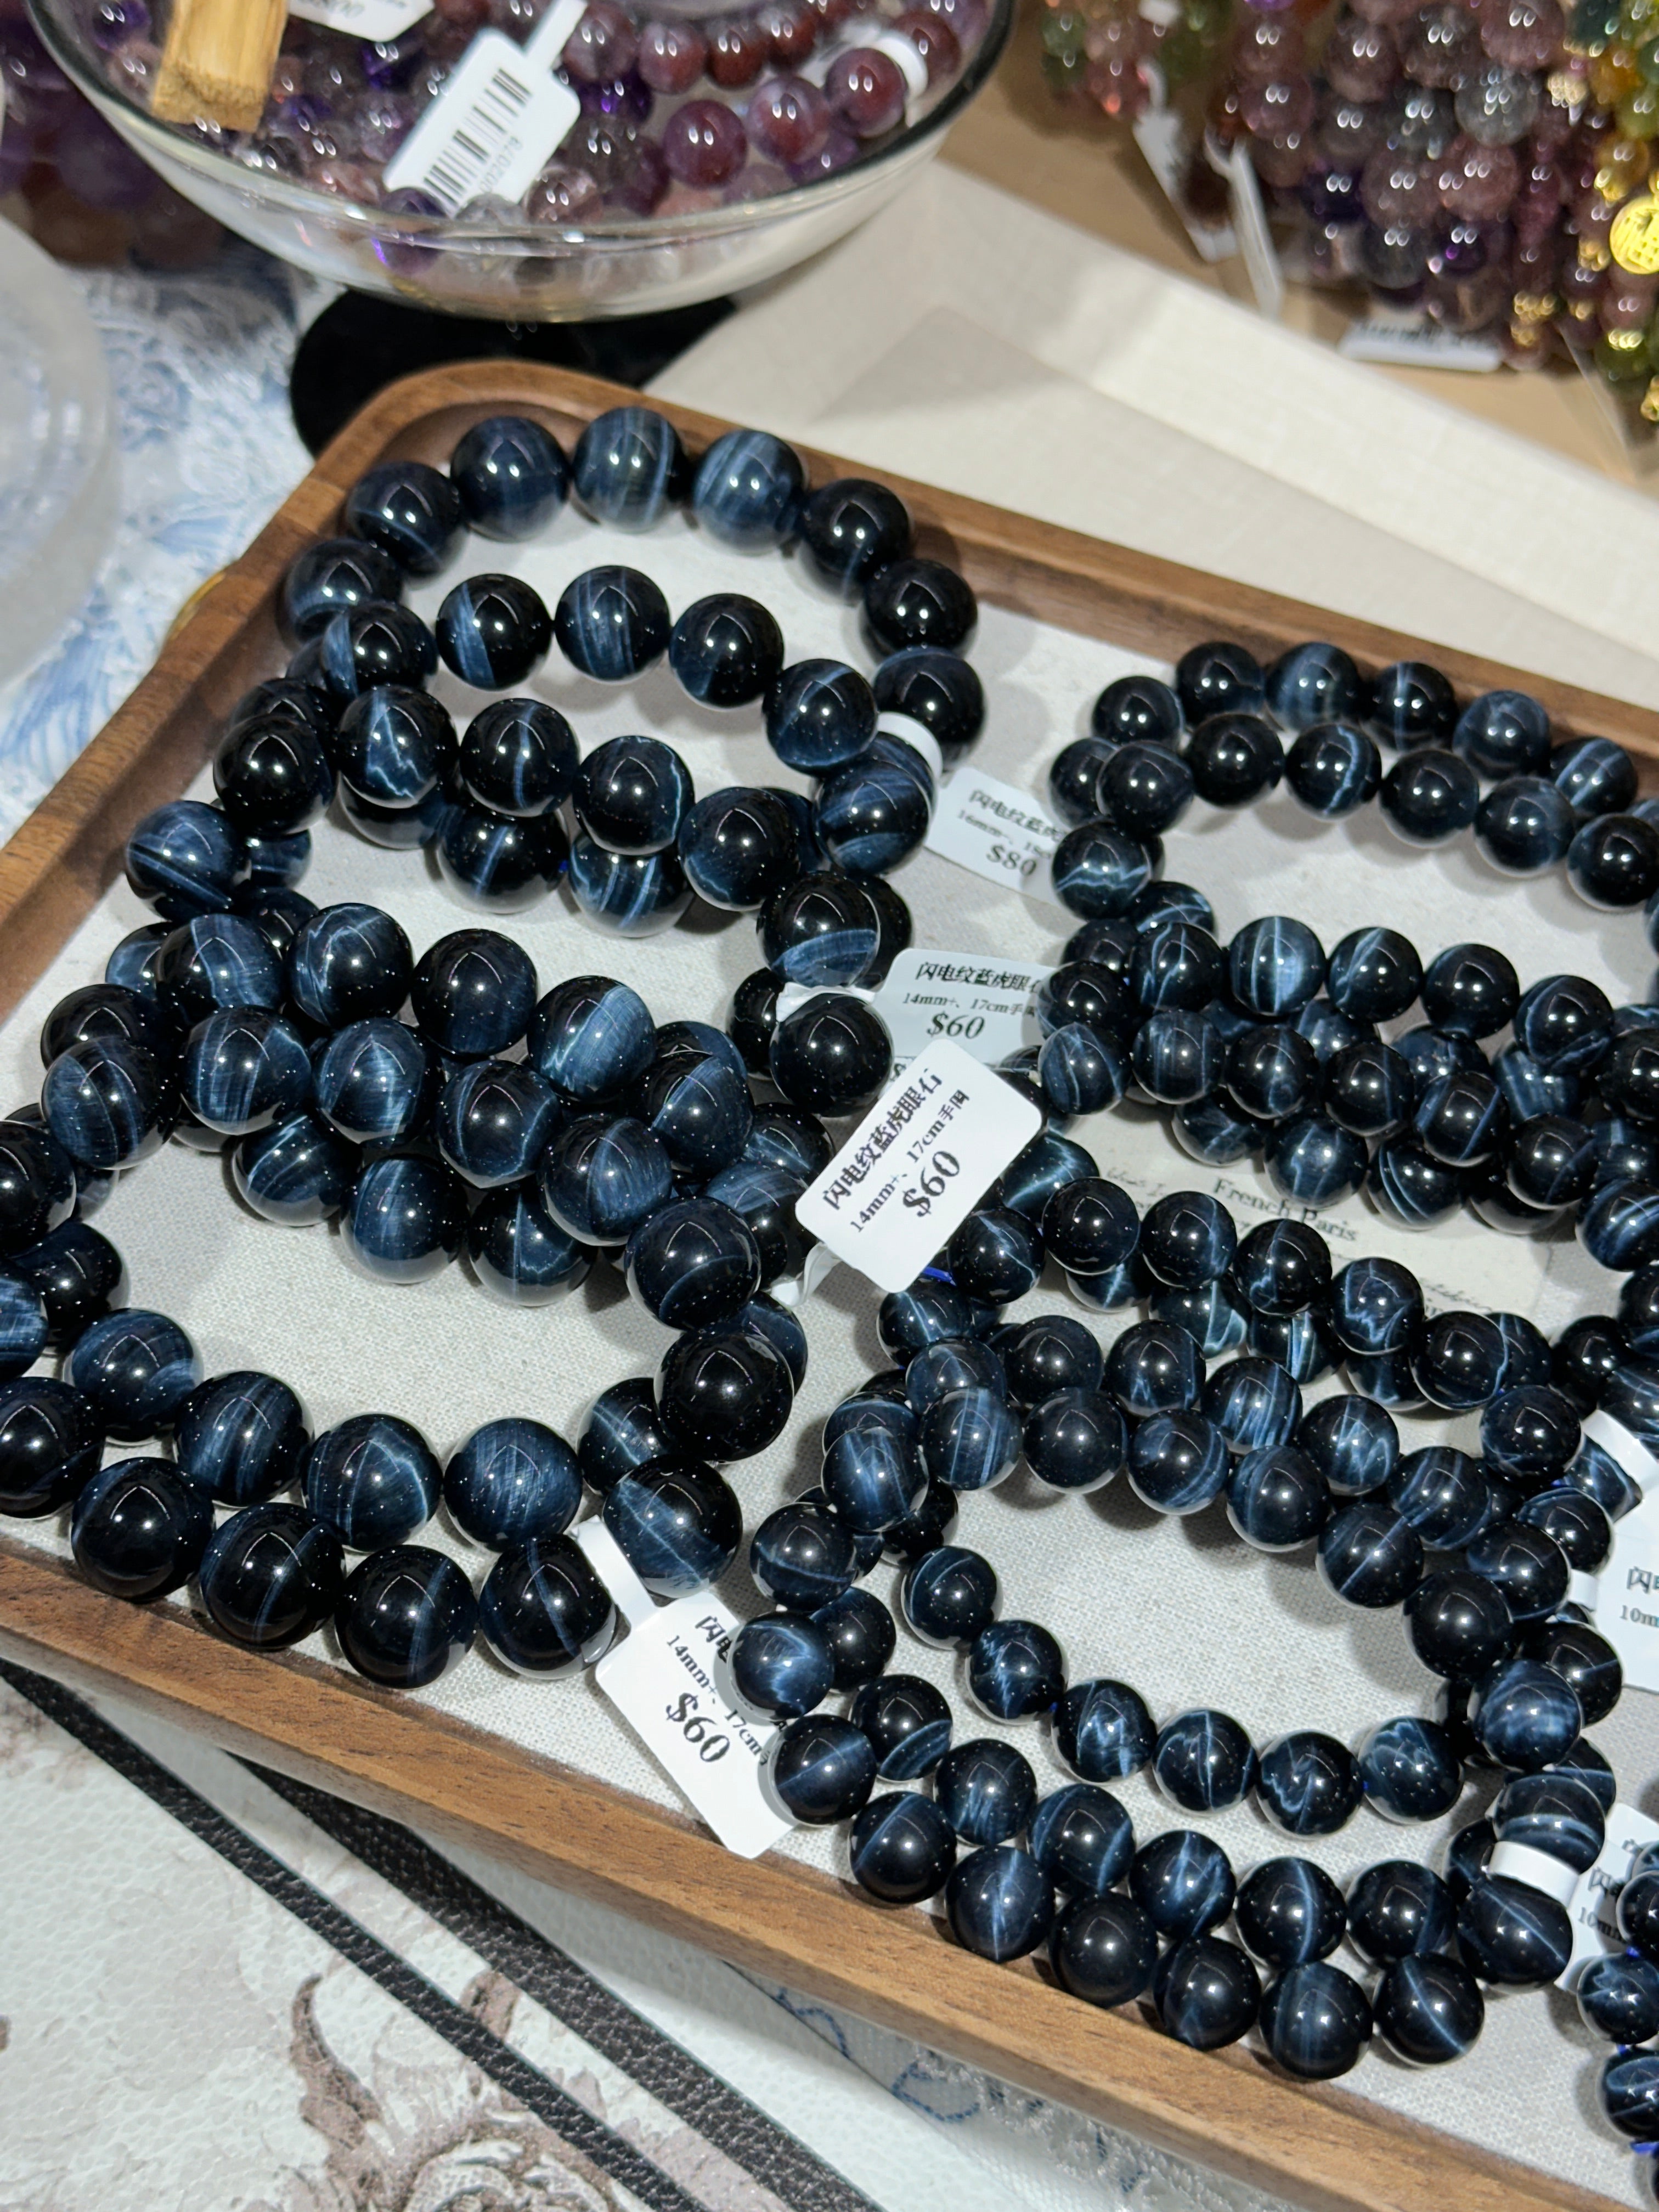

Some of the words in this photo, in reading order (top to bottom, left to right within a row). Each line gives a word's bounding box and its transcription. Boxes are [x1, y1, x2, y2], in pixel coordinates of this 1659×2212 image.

[969, 789, 1069, 843] 闪电纹蓝虎
[986, 844, 1037, 877] $80
[927, 1011, 985, 1039] $60
[902, 1150, 960, 1217] $60
[1213, 1178, 1290, 1217] French
[1300, 1207, 1357, 1241] Paris
[665, 1692, 730, 1763] $60
